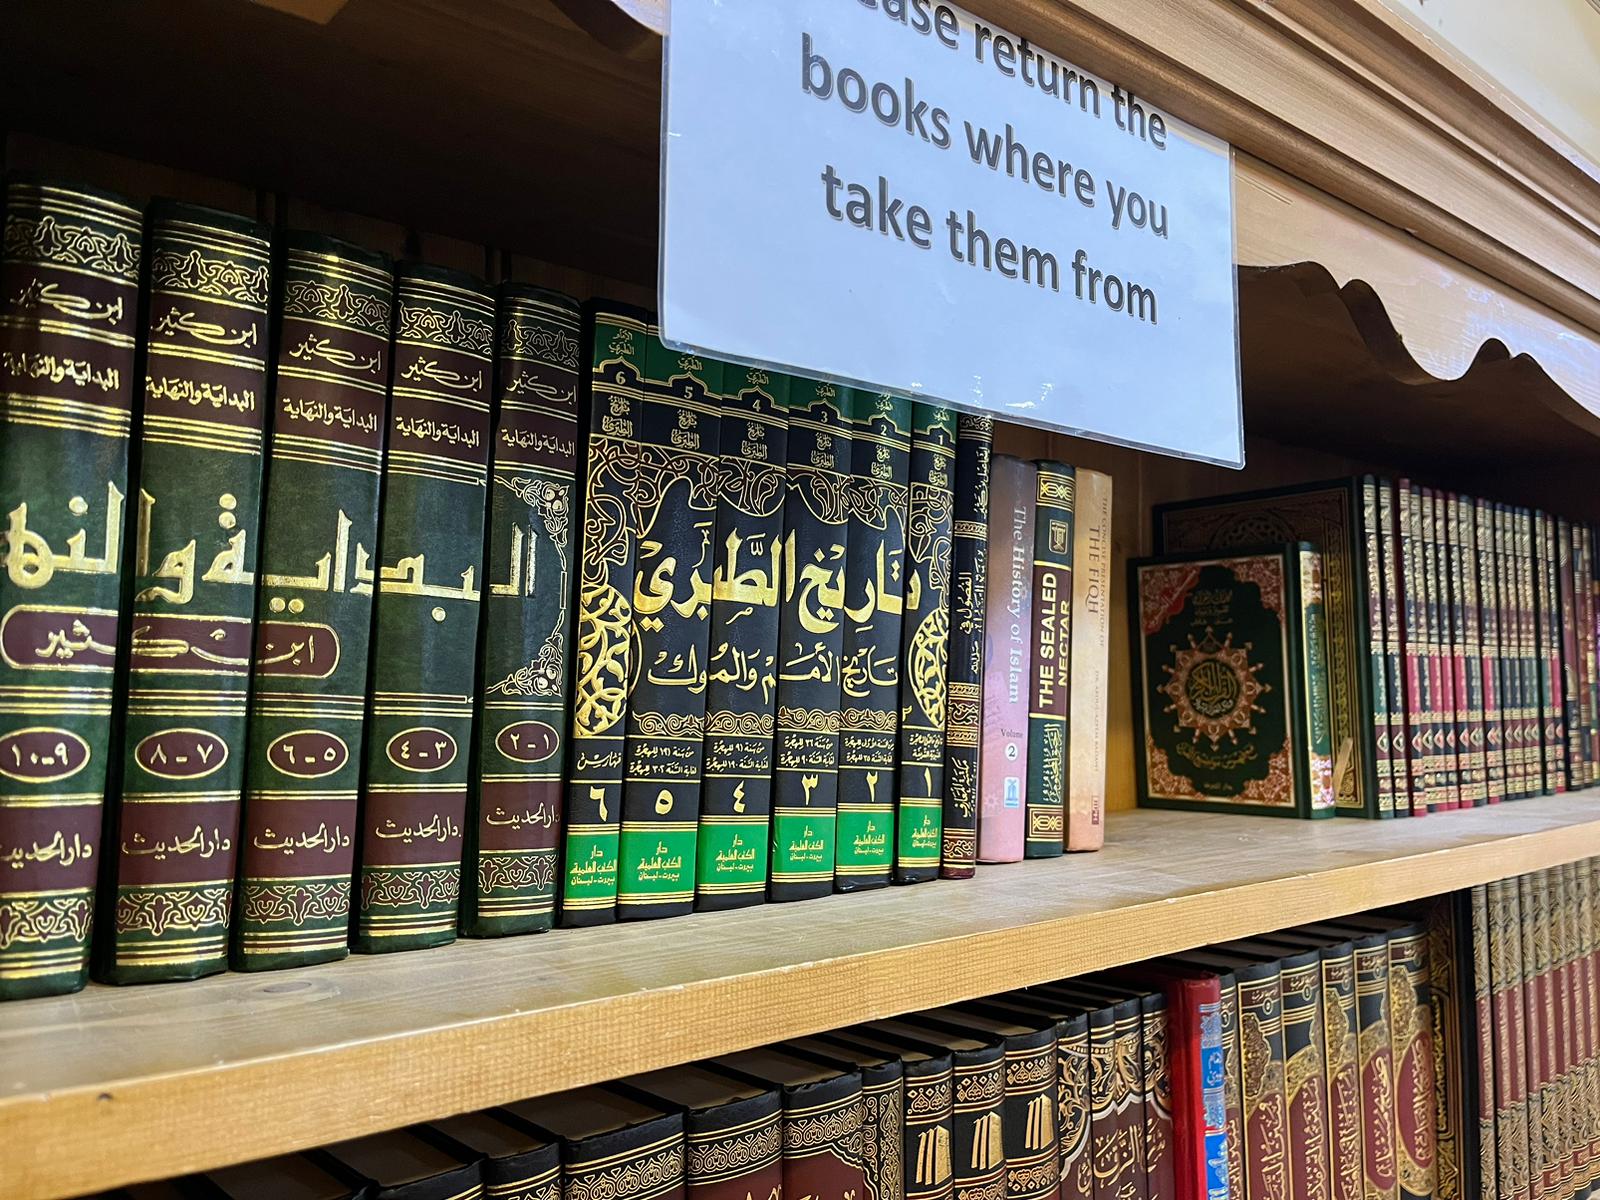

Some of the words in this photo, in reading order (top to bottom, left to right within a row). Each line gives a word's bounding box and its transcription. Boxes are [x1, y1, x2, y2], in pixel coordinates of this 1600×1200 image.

[856, 0, 959, 49] ase
[973, 22, 1101, 118] return
[1110, 84, 1168, 150] the
[801, 32, 951, 149] books
[963, 120, 1096, 208] where
[1106, 179, 1169, 239] you
[820, 164, 932, 249] take
[945, 209, 1060, 293] them
[1072, 248, 1158, 325] from
[150, 306, 226, 337] كثير
[289, 333, 356, 361] كثير
[401, 355, 461, 383] كثير
[506, 370, 558, 395] كثير
[615, 371, 626, 385] 6
[201, 381, 255, 413] البداية
[684, 386, 694, 399] 5
[752, 399, 761, 412] 4
[334, 405, 378, 434] البداية
[820, 411, 828, 424] 3
[880, 424, 887, 436] 2
[442, 425, 480, 449] البداية
[542, 435, 576, 457] البداية
[938, 434, 944, 446] 1
[1013, 506, 1027, 541] The
[1089, 526, 1100, 562] THE
[1007, 546, 1025, 619] History
[1085, 566, 1100, 614] FIQH
[1040, 572, 1057, 658] SEALED
[1010, 623, 1021, 645] of
[1058, 600, 1071, 687] NECTAR
[1009, 648, 1022, 703] Islam
[1039, 664, 1054, 709] THE
[1000, 727, 1024, 739] Volume
[1007, 745, 1016, 757] 2
[731, 780, 746, 814] ٤
[801, 773, 819, 806] ٣
[865, 771, 879, 803] ٢
[923, 767, 932, 798] ١
[486, 801, 546, 830] الحديث
[589, 785, 608, 822] ٦
[654, 789, 674, 815] ٥
[121, 825, 204, 861] الحديث
[199, 828, 232, 858] دار
[253, 822, 327, 856] الحديث
[324, 824, 351, 853] دار
[375, 813, 441, 844] الحديث
[437, 816, 459, 842] دار
[0, 830, 65, 869] الحدي
[61, 833, 93, 866] دار
